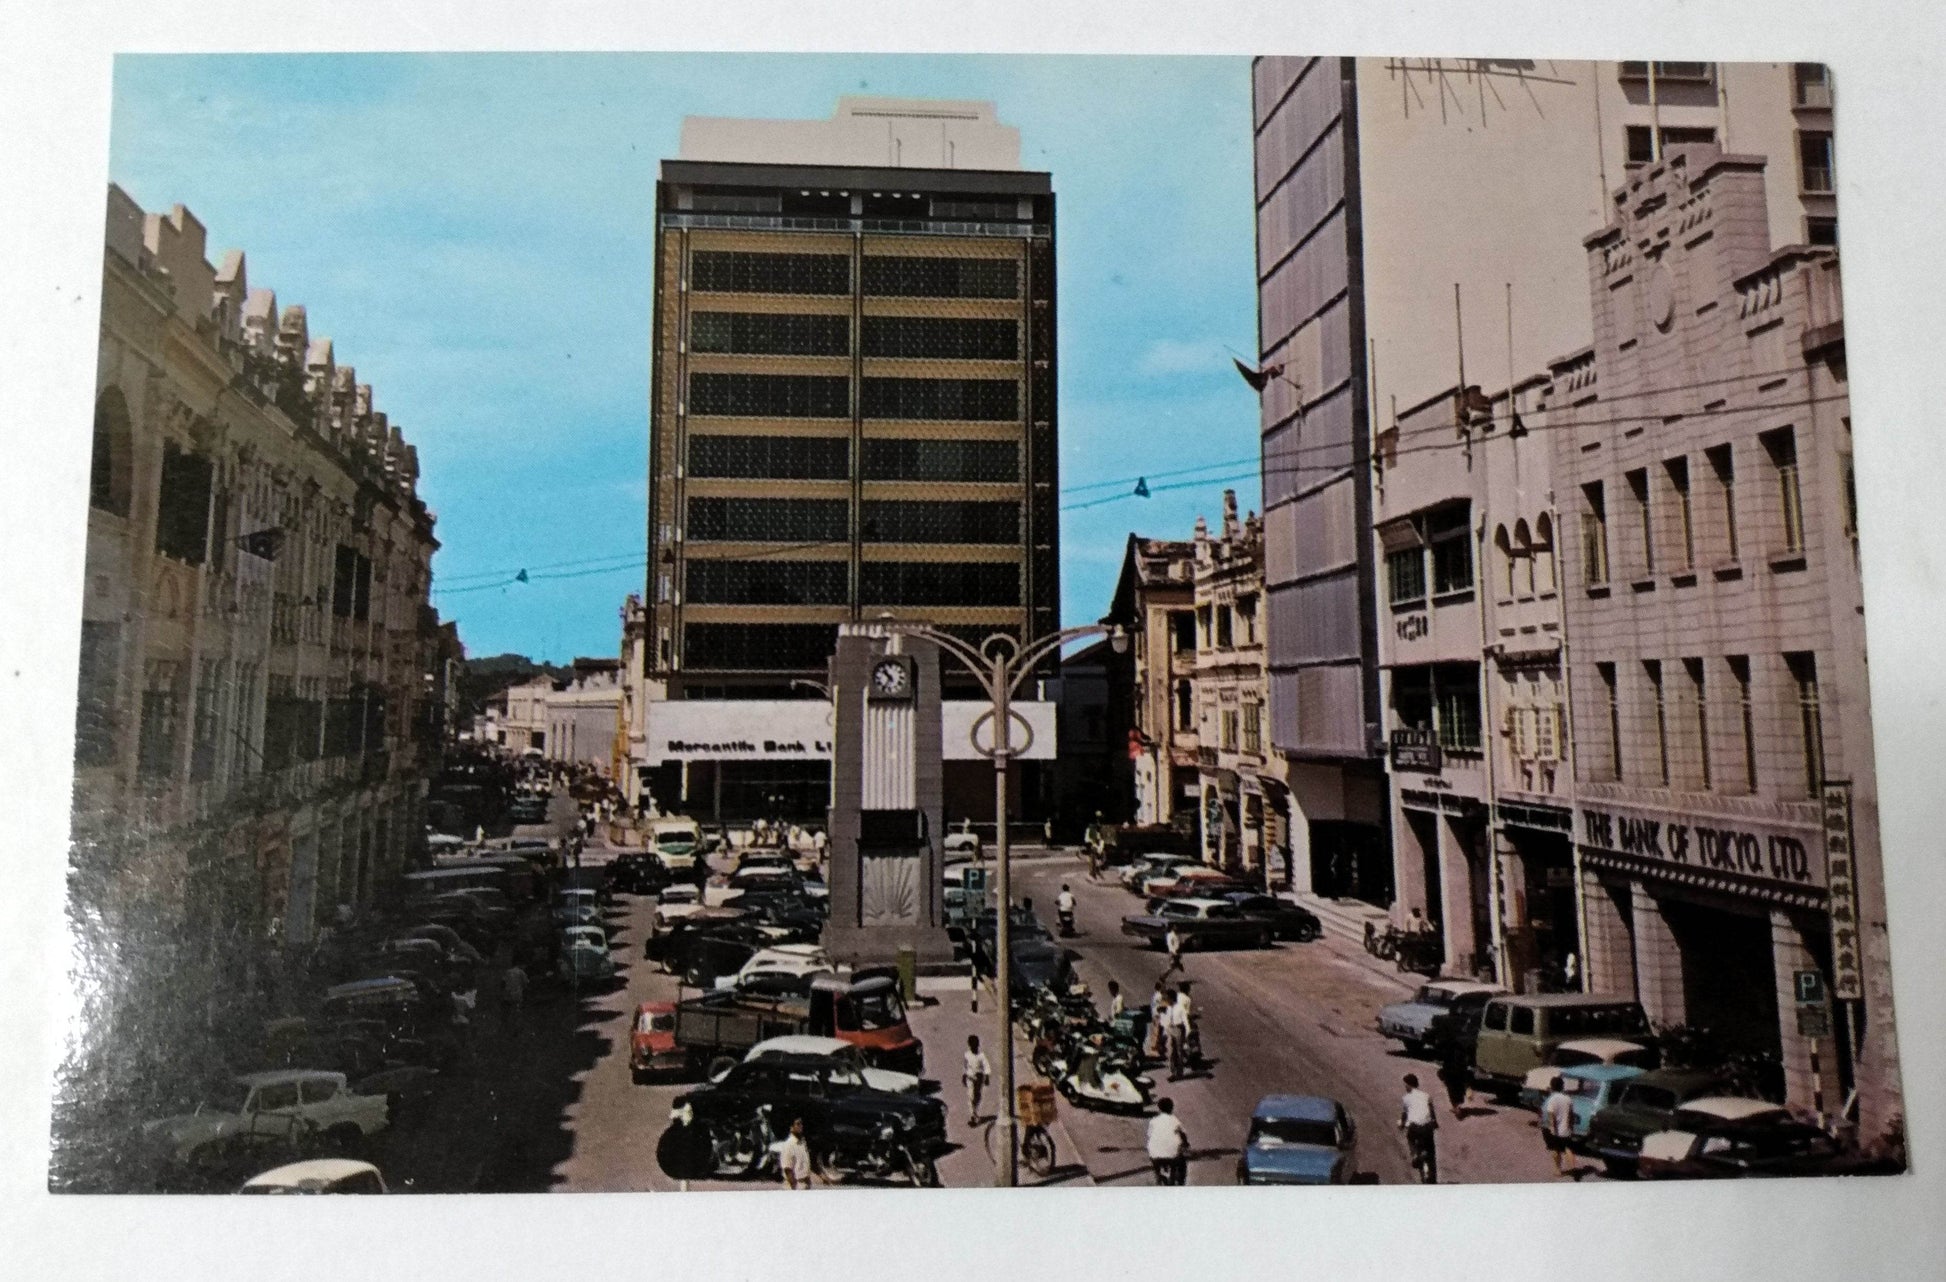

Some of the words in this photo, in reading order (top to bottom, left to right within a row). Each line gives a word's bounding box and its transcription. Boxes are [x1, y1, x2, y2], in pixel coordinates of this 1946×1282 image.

[763, 740, 806, 753] Bank
[1582, 809, 1614, 849] THE
[1618, 816, 1664, 859] BANK
[1667, 823, 1689, 863] OF
[968, 869, 980, 890] P
[1800, 973, 1816, 999] P
